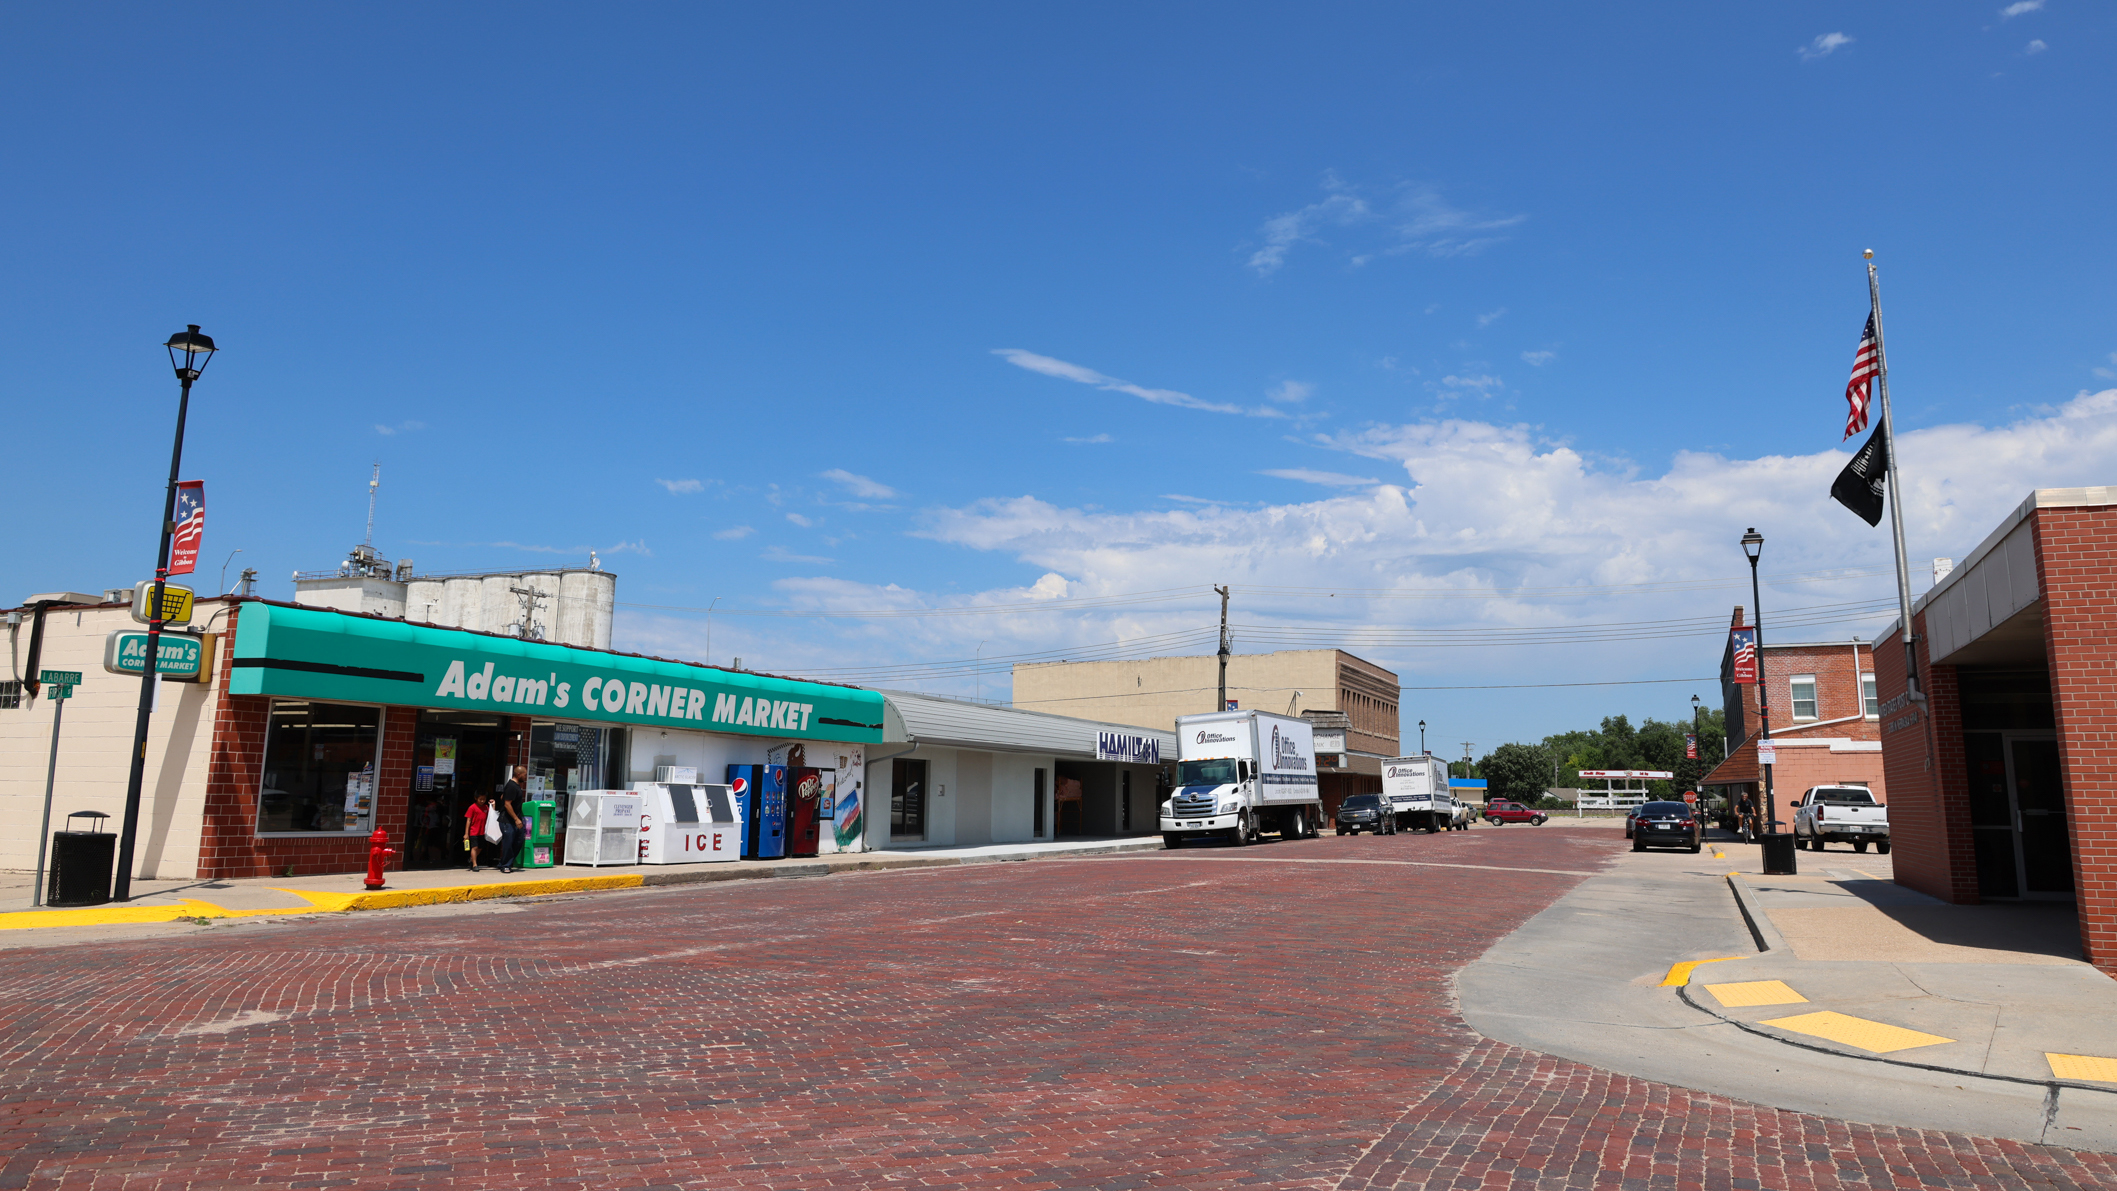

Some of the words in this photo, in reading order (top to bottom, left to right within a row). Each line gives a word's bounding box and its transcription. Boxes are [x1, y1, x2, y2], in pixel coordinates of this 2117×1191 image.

[1851, 456, 1869, 478] POW
[122, 658, 158, 668] CORN
[160, 661, 194, 670] MARKET
[42, 672, 80, 683] LABARRE
[436, 660, 572, 708] Adam's
[582, 676, 706, 720] CORNER
[712, 692, 813, 730] MARKET
[1281, 736, 1295, 755] Office
[1280, 752, 1307, 770] Innovations
[799, 781, 818, 798] Pepper
[807, 778, 814, 788] Dr
[686, 832, 722, 851] ICE
